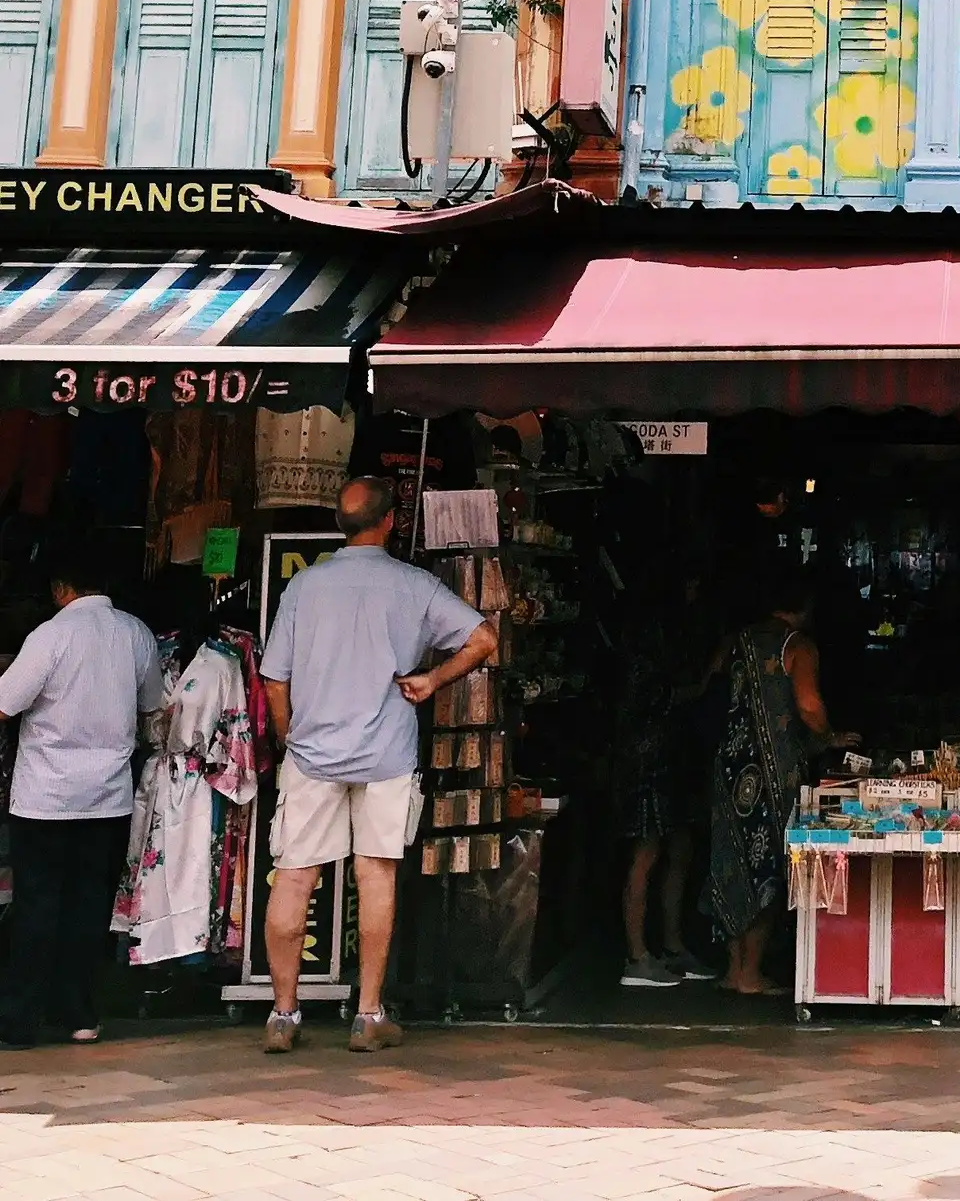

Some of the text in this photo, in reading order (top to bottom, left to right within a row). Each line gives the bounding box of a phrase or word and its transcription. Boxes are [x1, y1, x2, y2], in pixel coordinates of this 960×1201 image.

[52, 368, 77, 403] 3
[93, 369, 156, 403] for
[672, 425, 690, 438] ST
